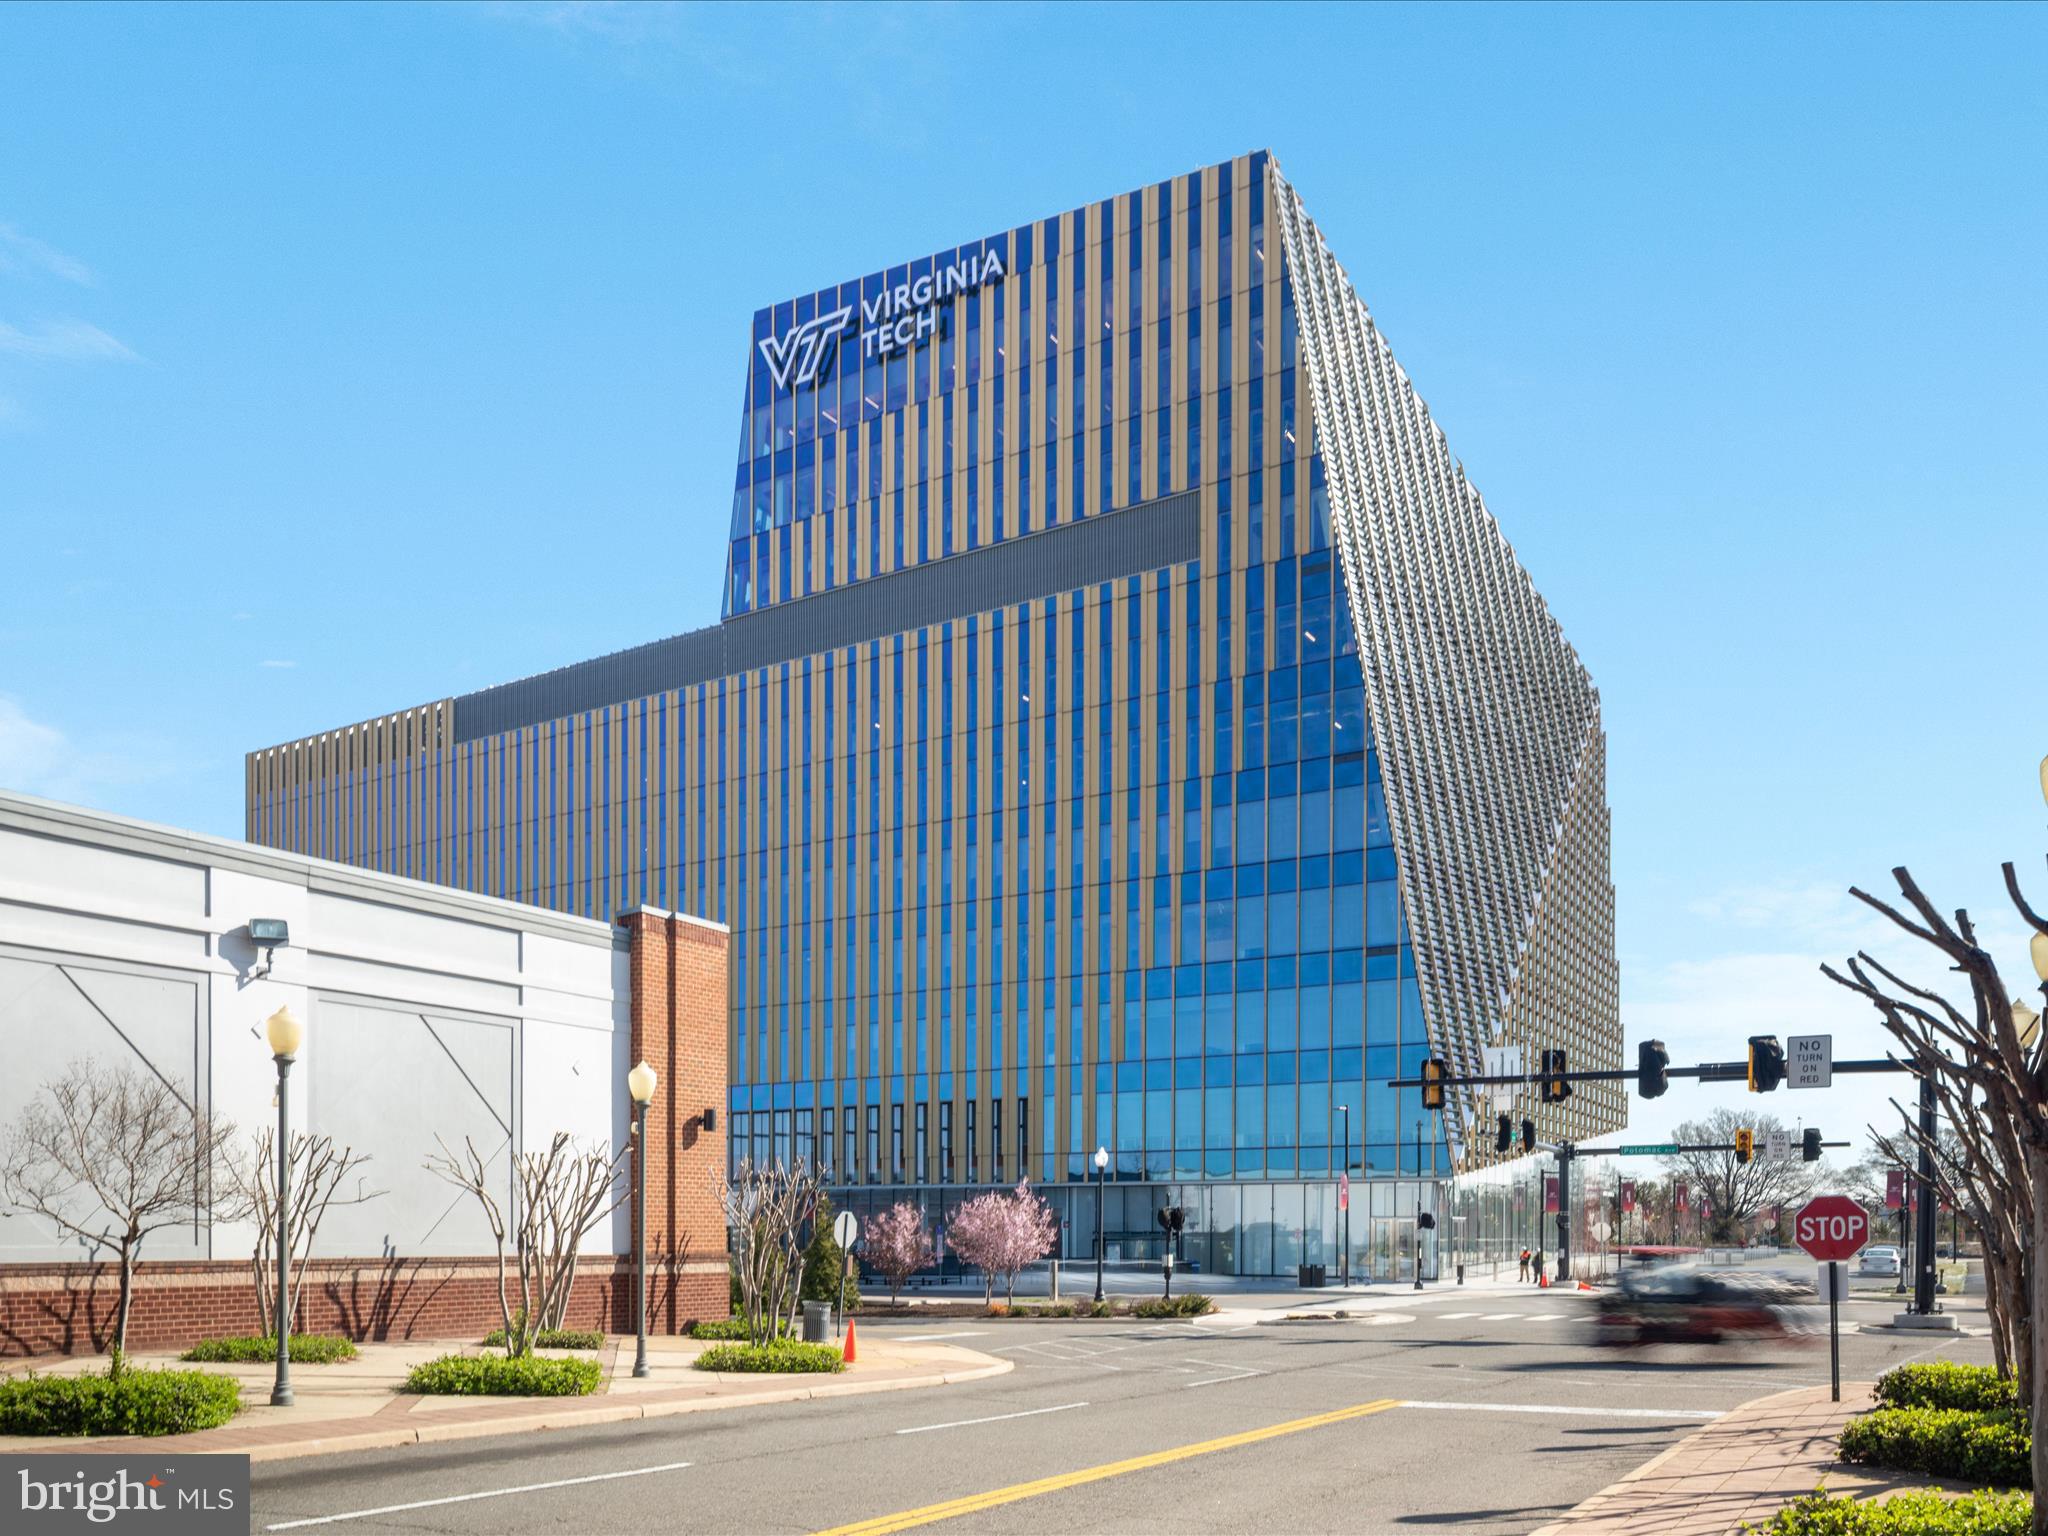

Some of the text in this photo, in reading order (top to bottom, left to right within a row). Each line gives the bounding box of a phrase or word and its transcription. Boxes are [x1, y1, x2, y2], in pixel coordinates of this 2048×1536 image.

[863, 248, 1004, 324] VIRGINIA
[862, 306, 936, 358] TECH
[758, 304, 853, 390] VT
[1799, 1040, 1821, 1051] NO
[1797, 1053, 1823, 1062] TURN
[1802, 1064, 1817, 1073] ON
[1800, 1074, 1819, 1084] RED
[1623, 1146, 1662, 1154] Potomac
[1800, 1215, 1864, 1242] STOP
